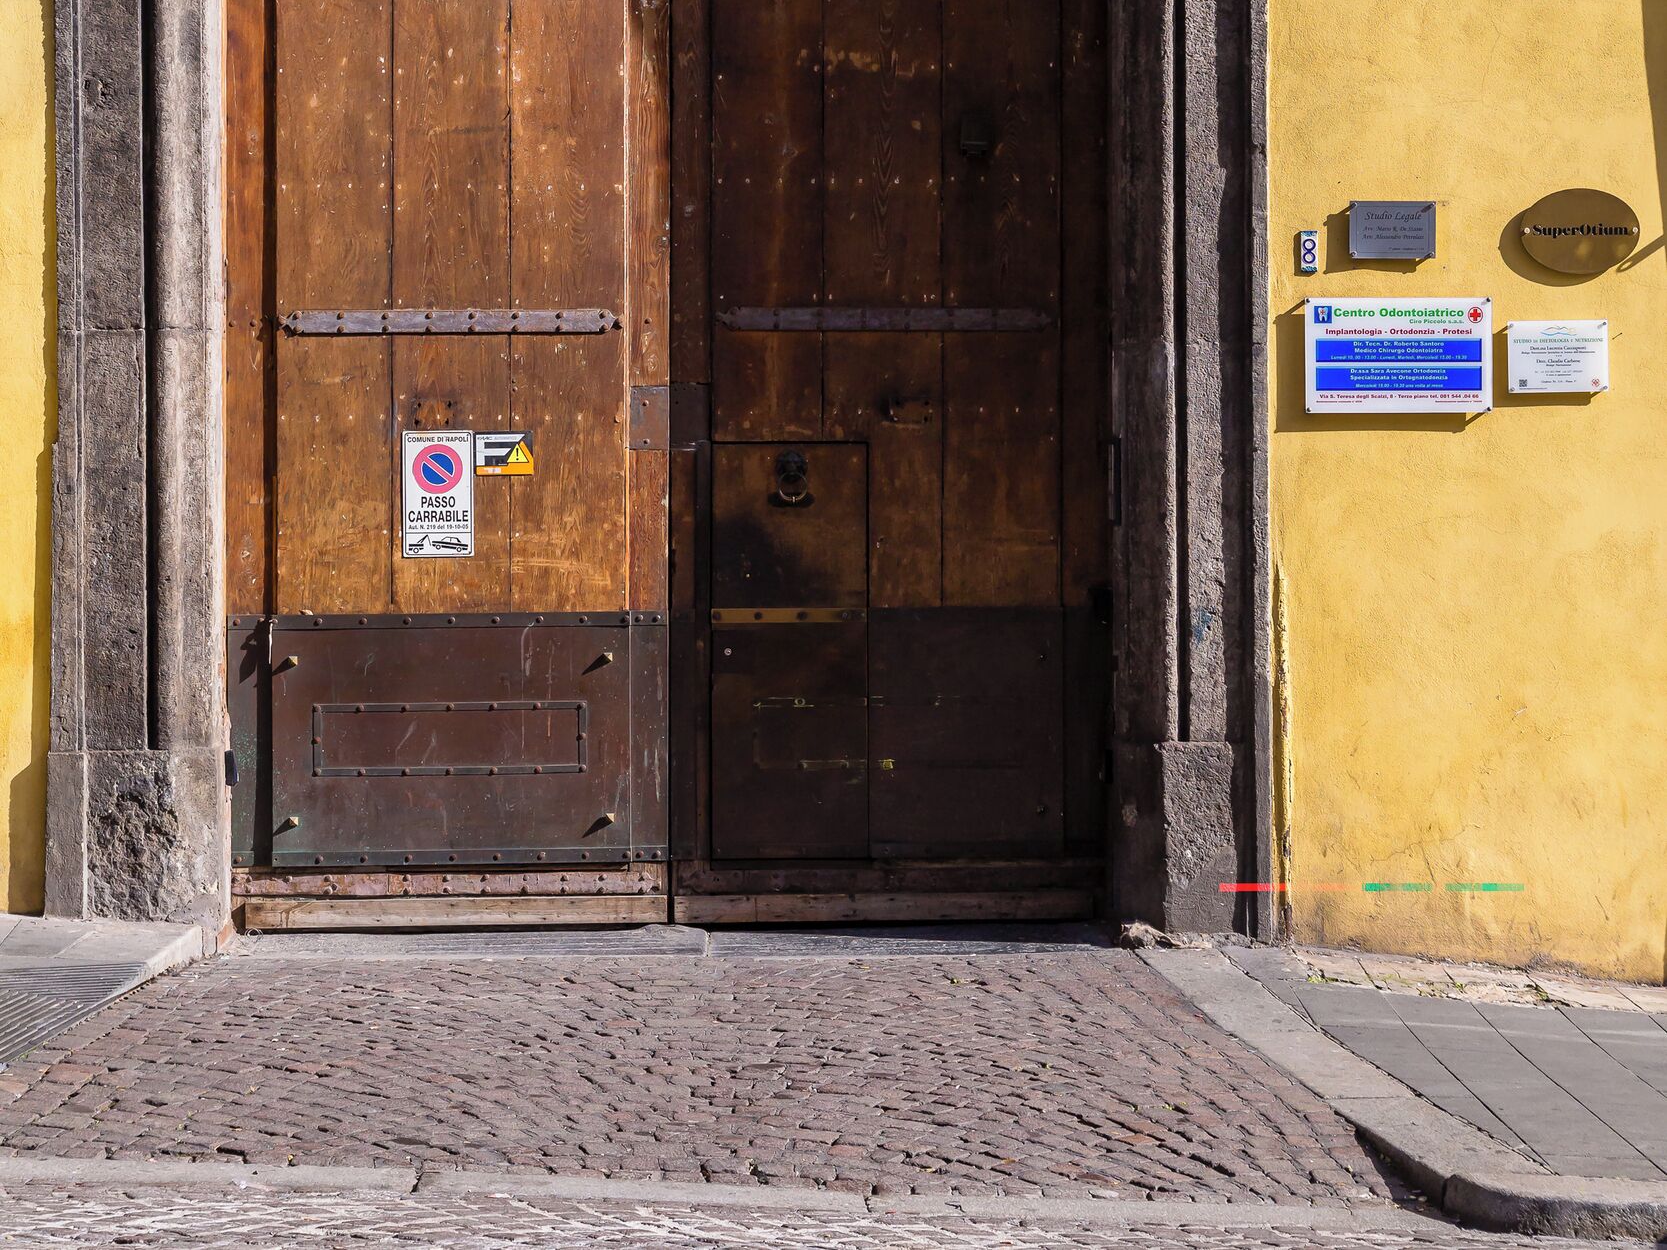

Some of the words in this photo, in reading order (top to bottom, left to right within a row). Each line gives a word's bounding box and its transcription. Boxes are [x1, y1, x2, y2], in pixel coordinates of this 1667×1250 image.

[1365, 210, 1392, 220] Studio
[1395, 211, 1421, 222] Legale
[1533, 224, 1629, 238] SuperOtium
[1303, 238, 1316, 264] 8
[1334, 309, 1375, 317] Centro
[1380, 308, 1464, 317] Odontoiatrico
[421, 496, 455, 508] PASSO
[408, 511, 468, 522] CARRABILE
